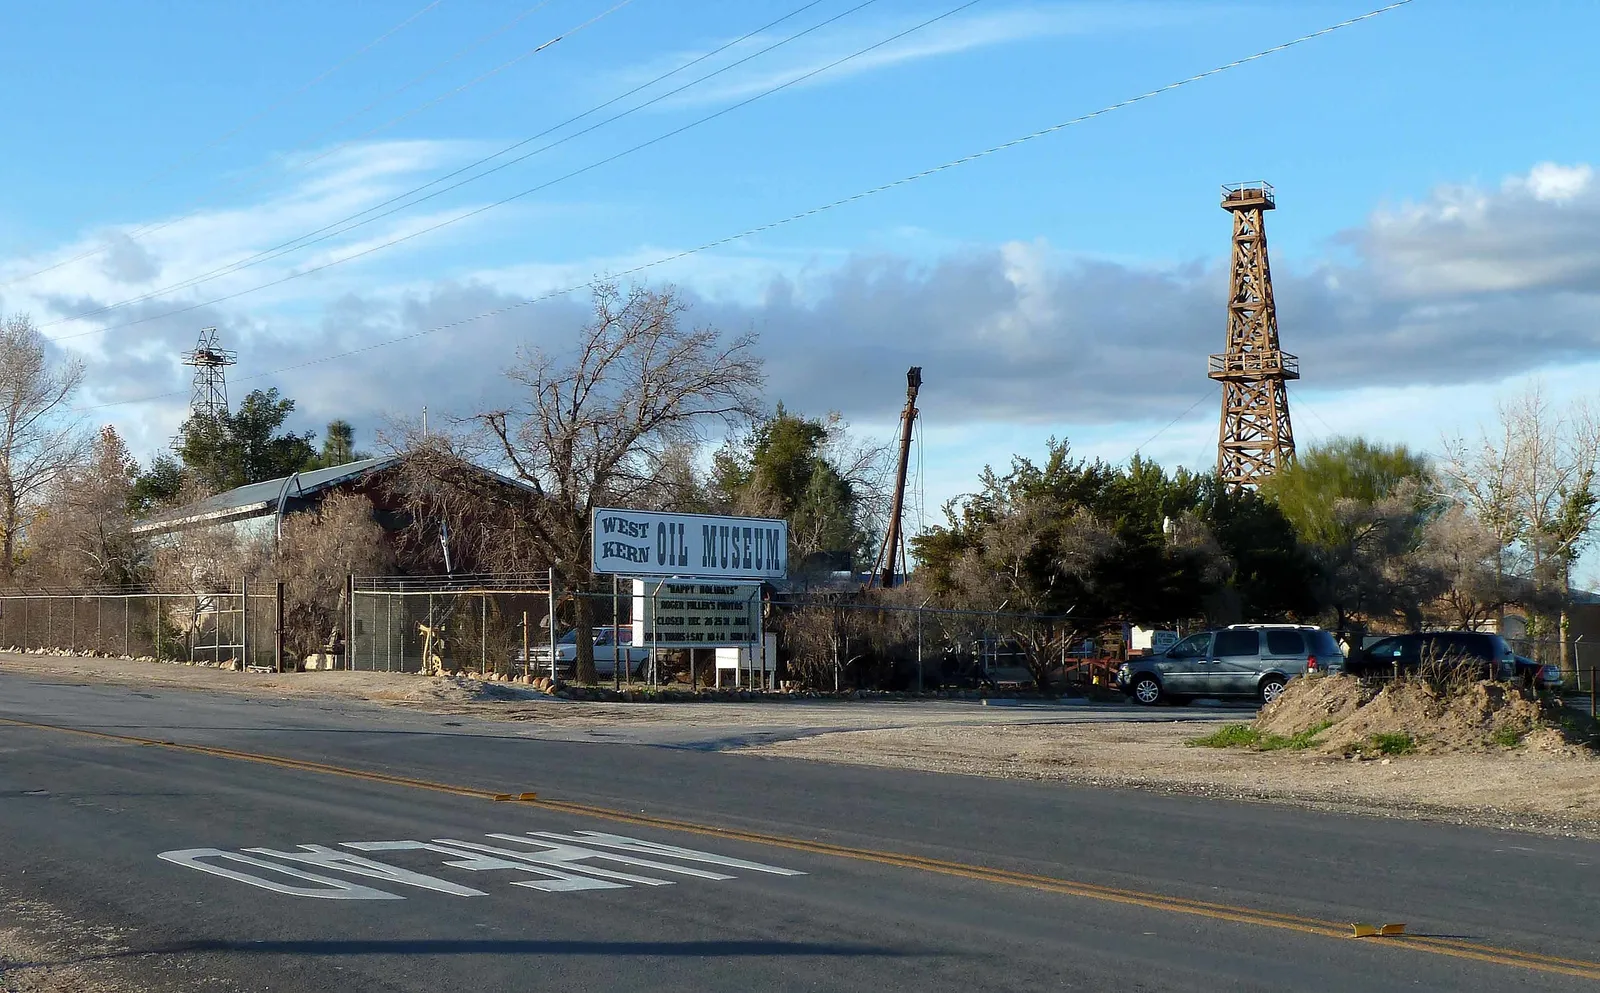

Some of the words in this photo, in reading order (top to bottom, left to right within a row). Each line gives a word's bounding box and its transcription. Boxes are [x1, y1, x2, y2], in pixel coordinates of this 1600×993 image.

[602, 517, 649, 538] WEST
[602, 541, 650, 563] KERN
[657, 521, 688, 566] OIL
[702, 524, 780, 571] MUSEUM
[660, 600, 684, 610] ROGER
[656, 616, 684, 626] CLOSED
[688, 617, 701, 626] DEC
[157, 829, 810, 900] AHEAD
